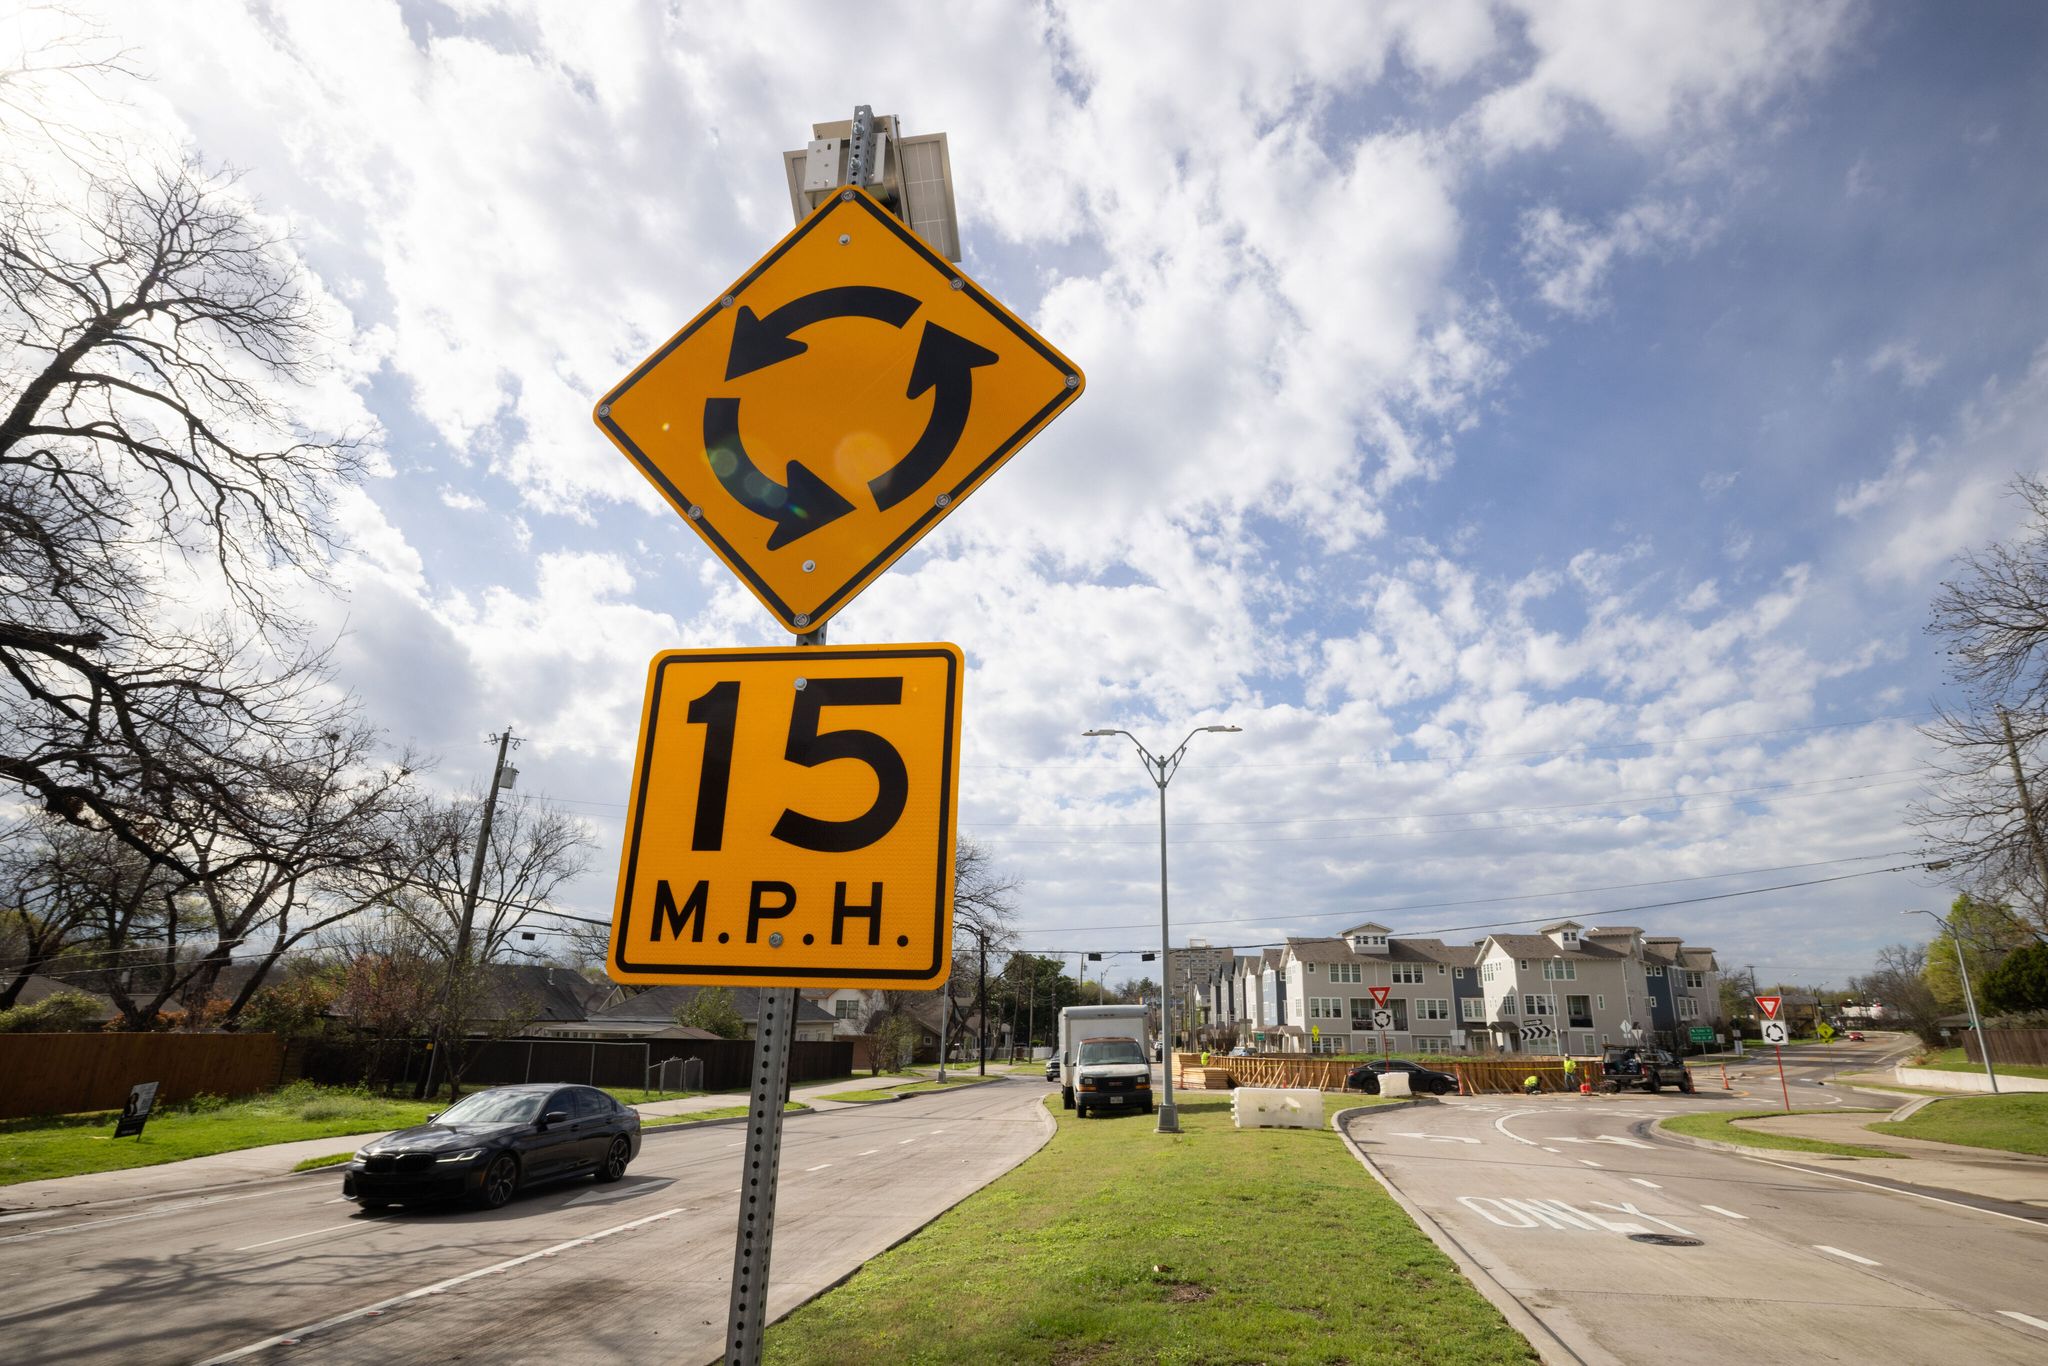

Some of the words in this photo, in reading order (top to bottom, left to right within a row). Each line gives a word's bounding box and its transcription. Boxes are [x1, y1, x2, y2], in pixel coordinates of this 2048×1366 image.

[686, 676, 909, 853] 15
[650, 879, 909, 948] M.P.H.
[1456, 1196, 1697, 1235] ONLY
